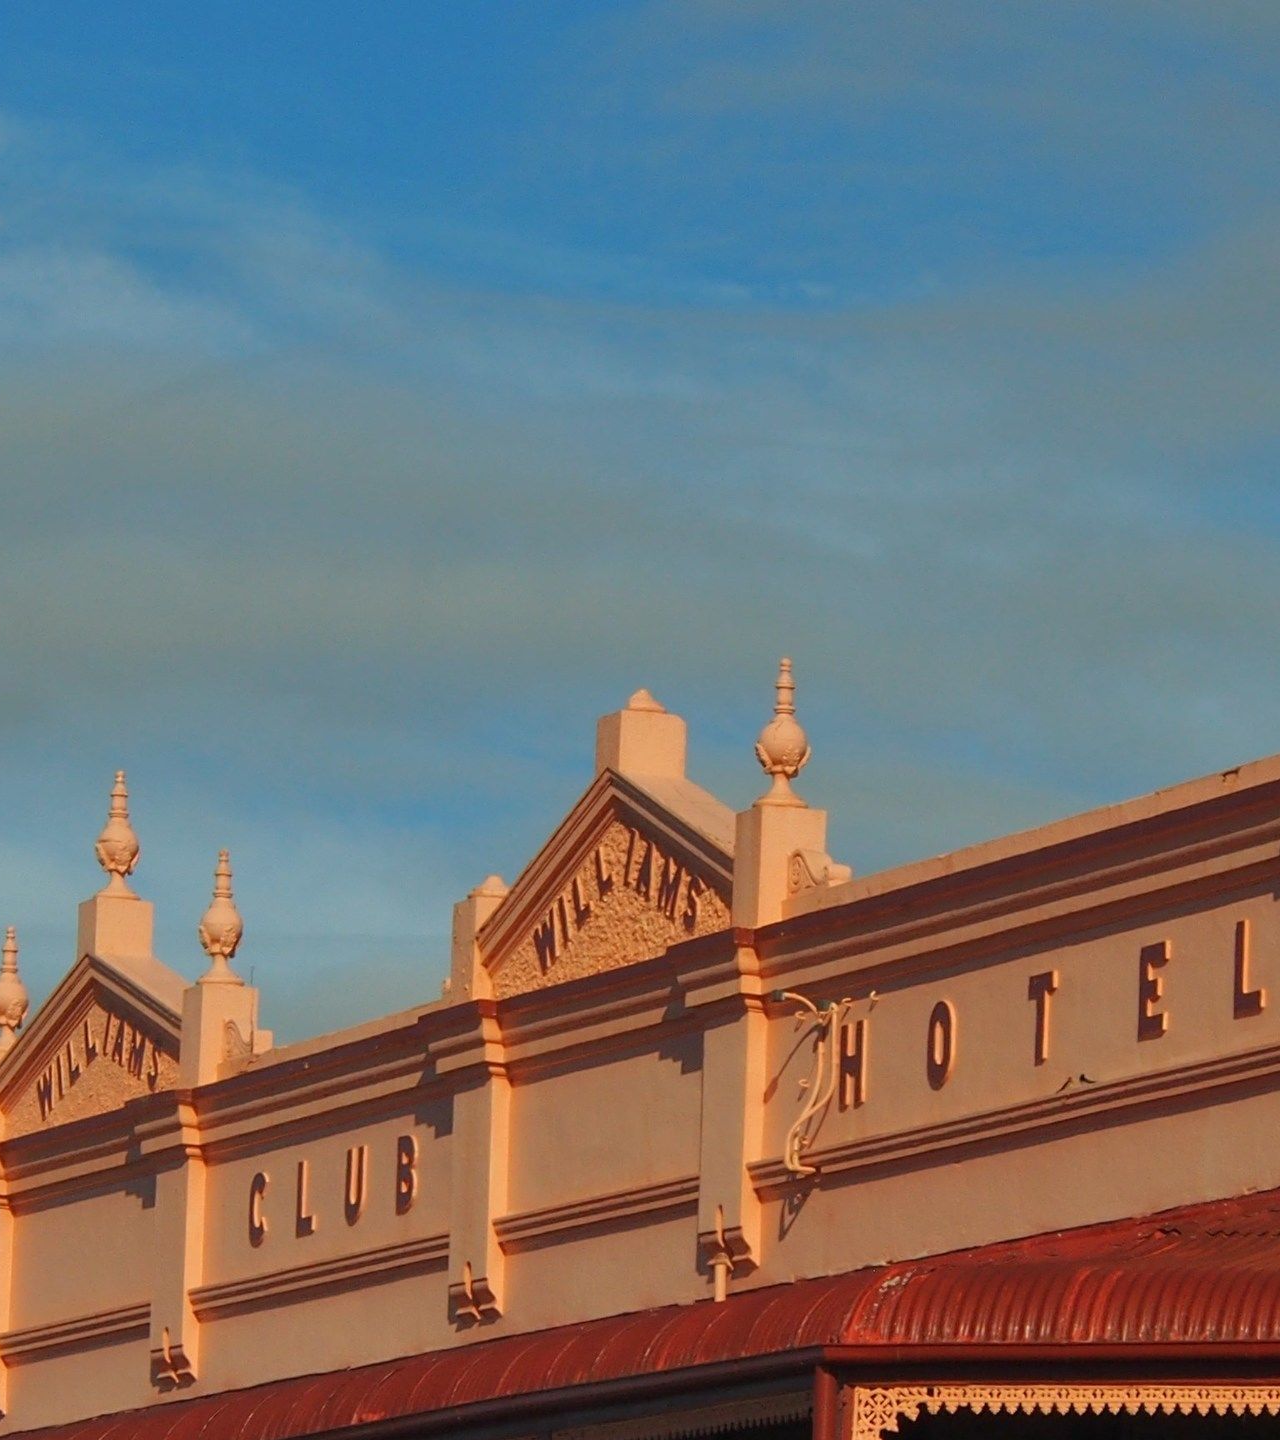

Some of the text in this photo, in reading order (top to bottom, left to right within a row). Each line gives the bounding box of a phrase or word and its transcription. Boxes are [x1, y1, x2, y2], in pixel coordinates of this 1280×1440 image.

[534, 827, 708, 976] WILLIAMS
[37, 1012, 160, 1121] WILLIAMS
[838, 919, 1267, 1113] HOTEL
[248, 1134, 418, 1249] CLUB
